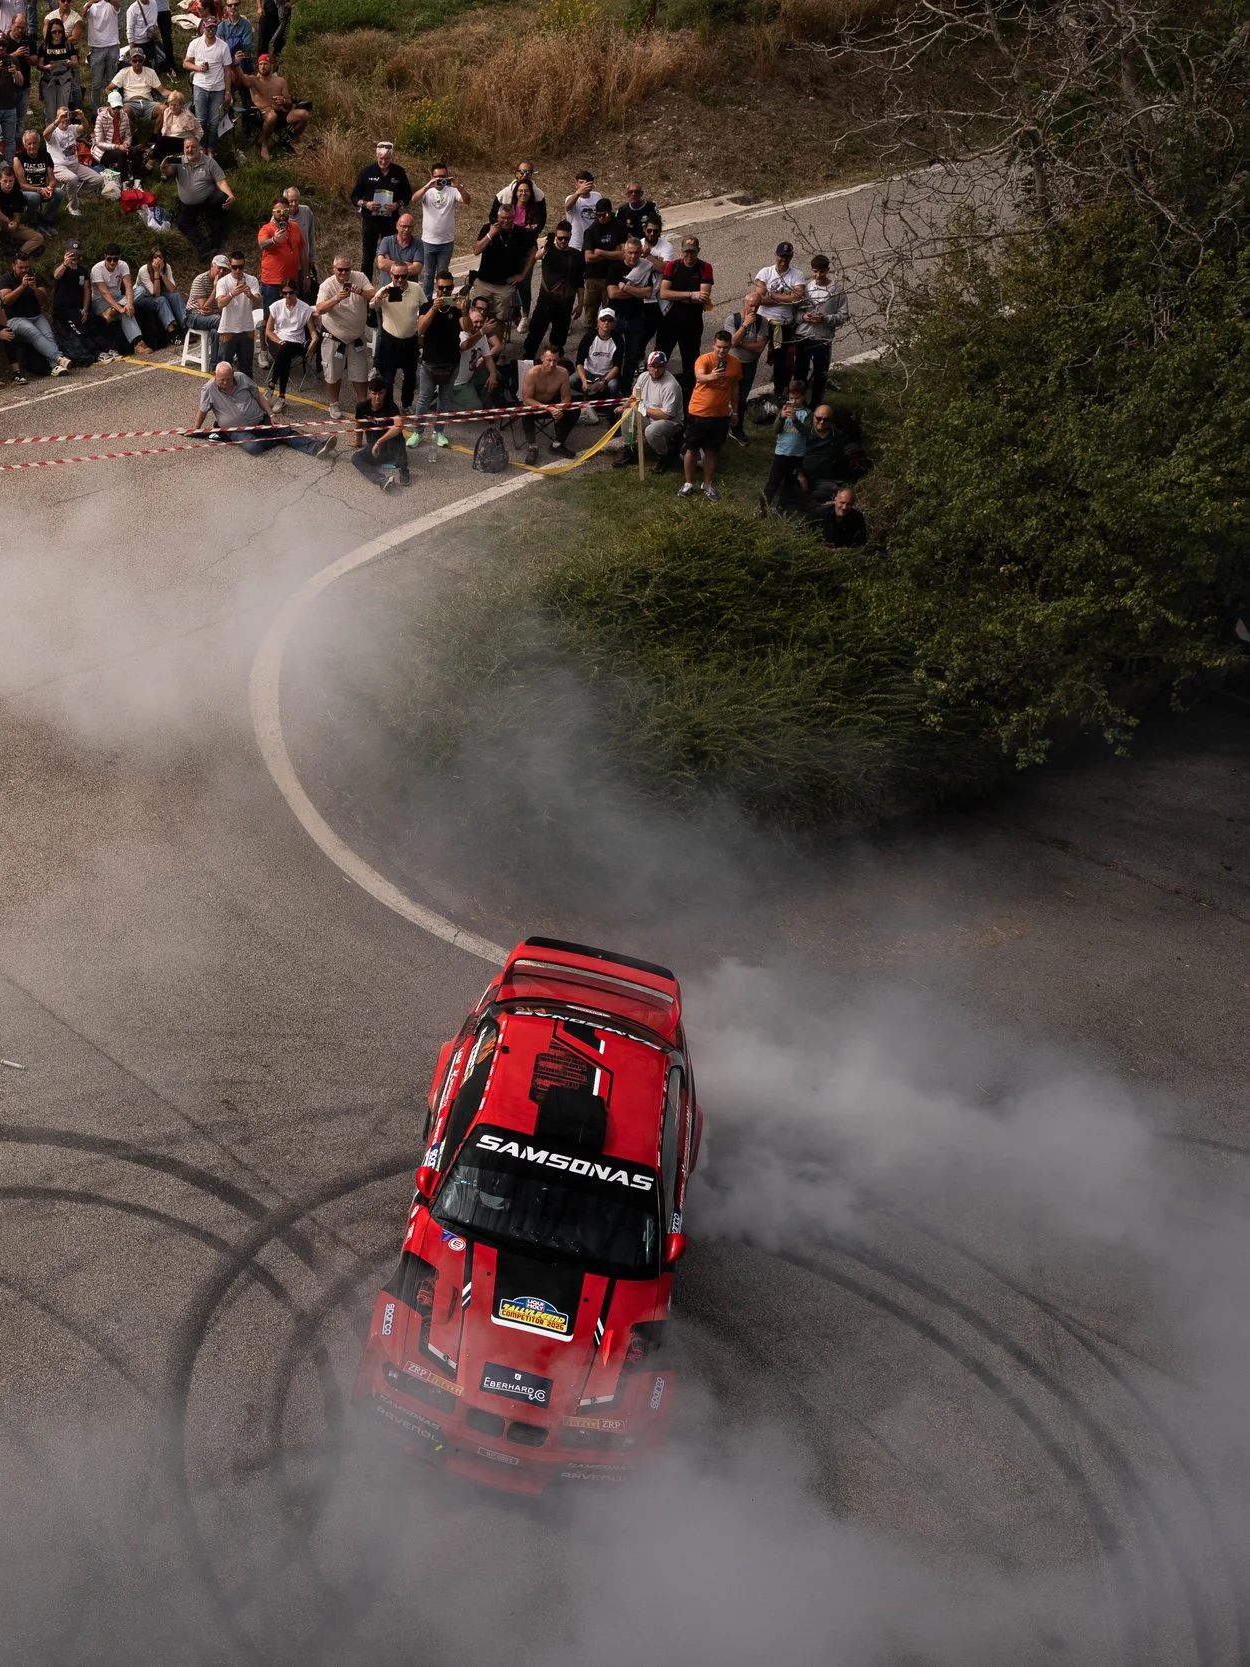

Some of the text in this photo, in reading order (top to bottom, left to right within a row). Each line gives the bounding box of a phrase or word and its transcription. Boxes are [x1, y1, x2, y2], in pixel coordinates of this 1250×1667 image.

[476, 1134, 654, 1191] SAMSONAS
[382, 1303, 396, 1336] sparco
[502, 1310, 545, 1326] COMPETITOR
[408, 1363, 427, 1376] ZRP
[650, 1377, 665, 1410] sparco
[602, 1420, 621, 1429] ZRP
